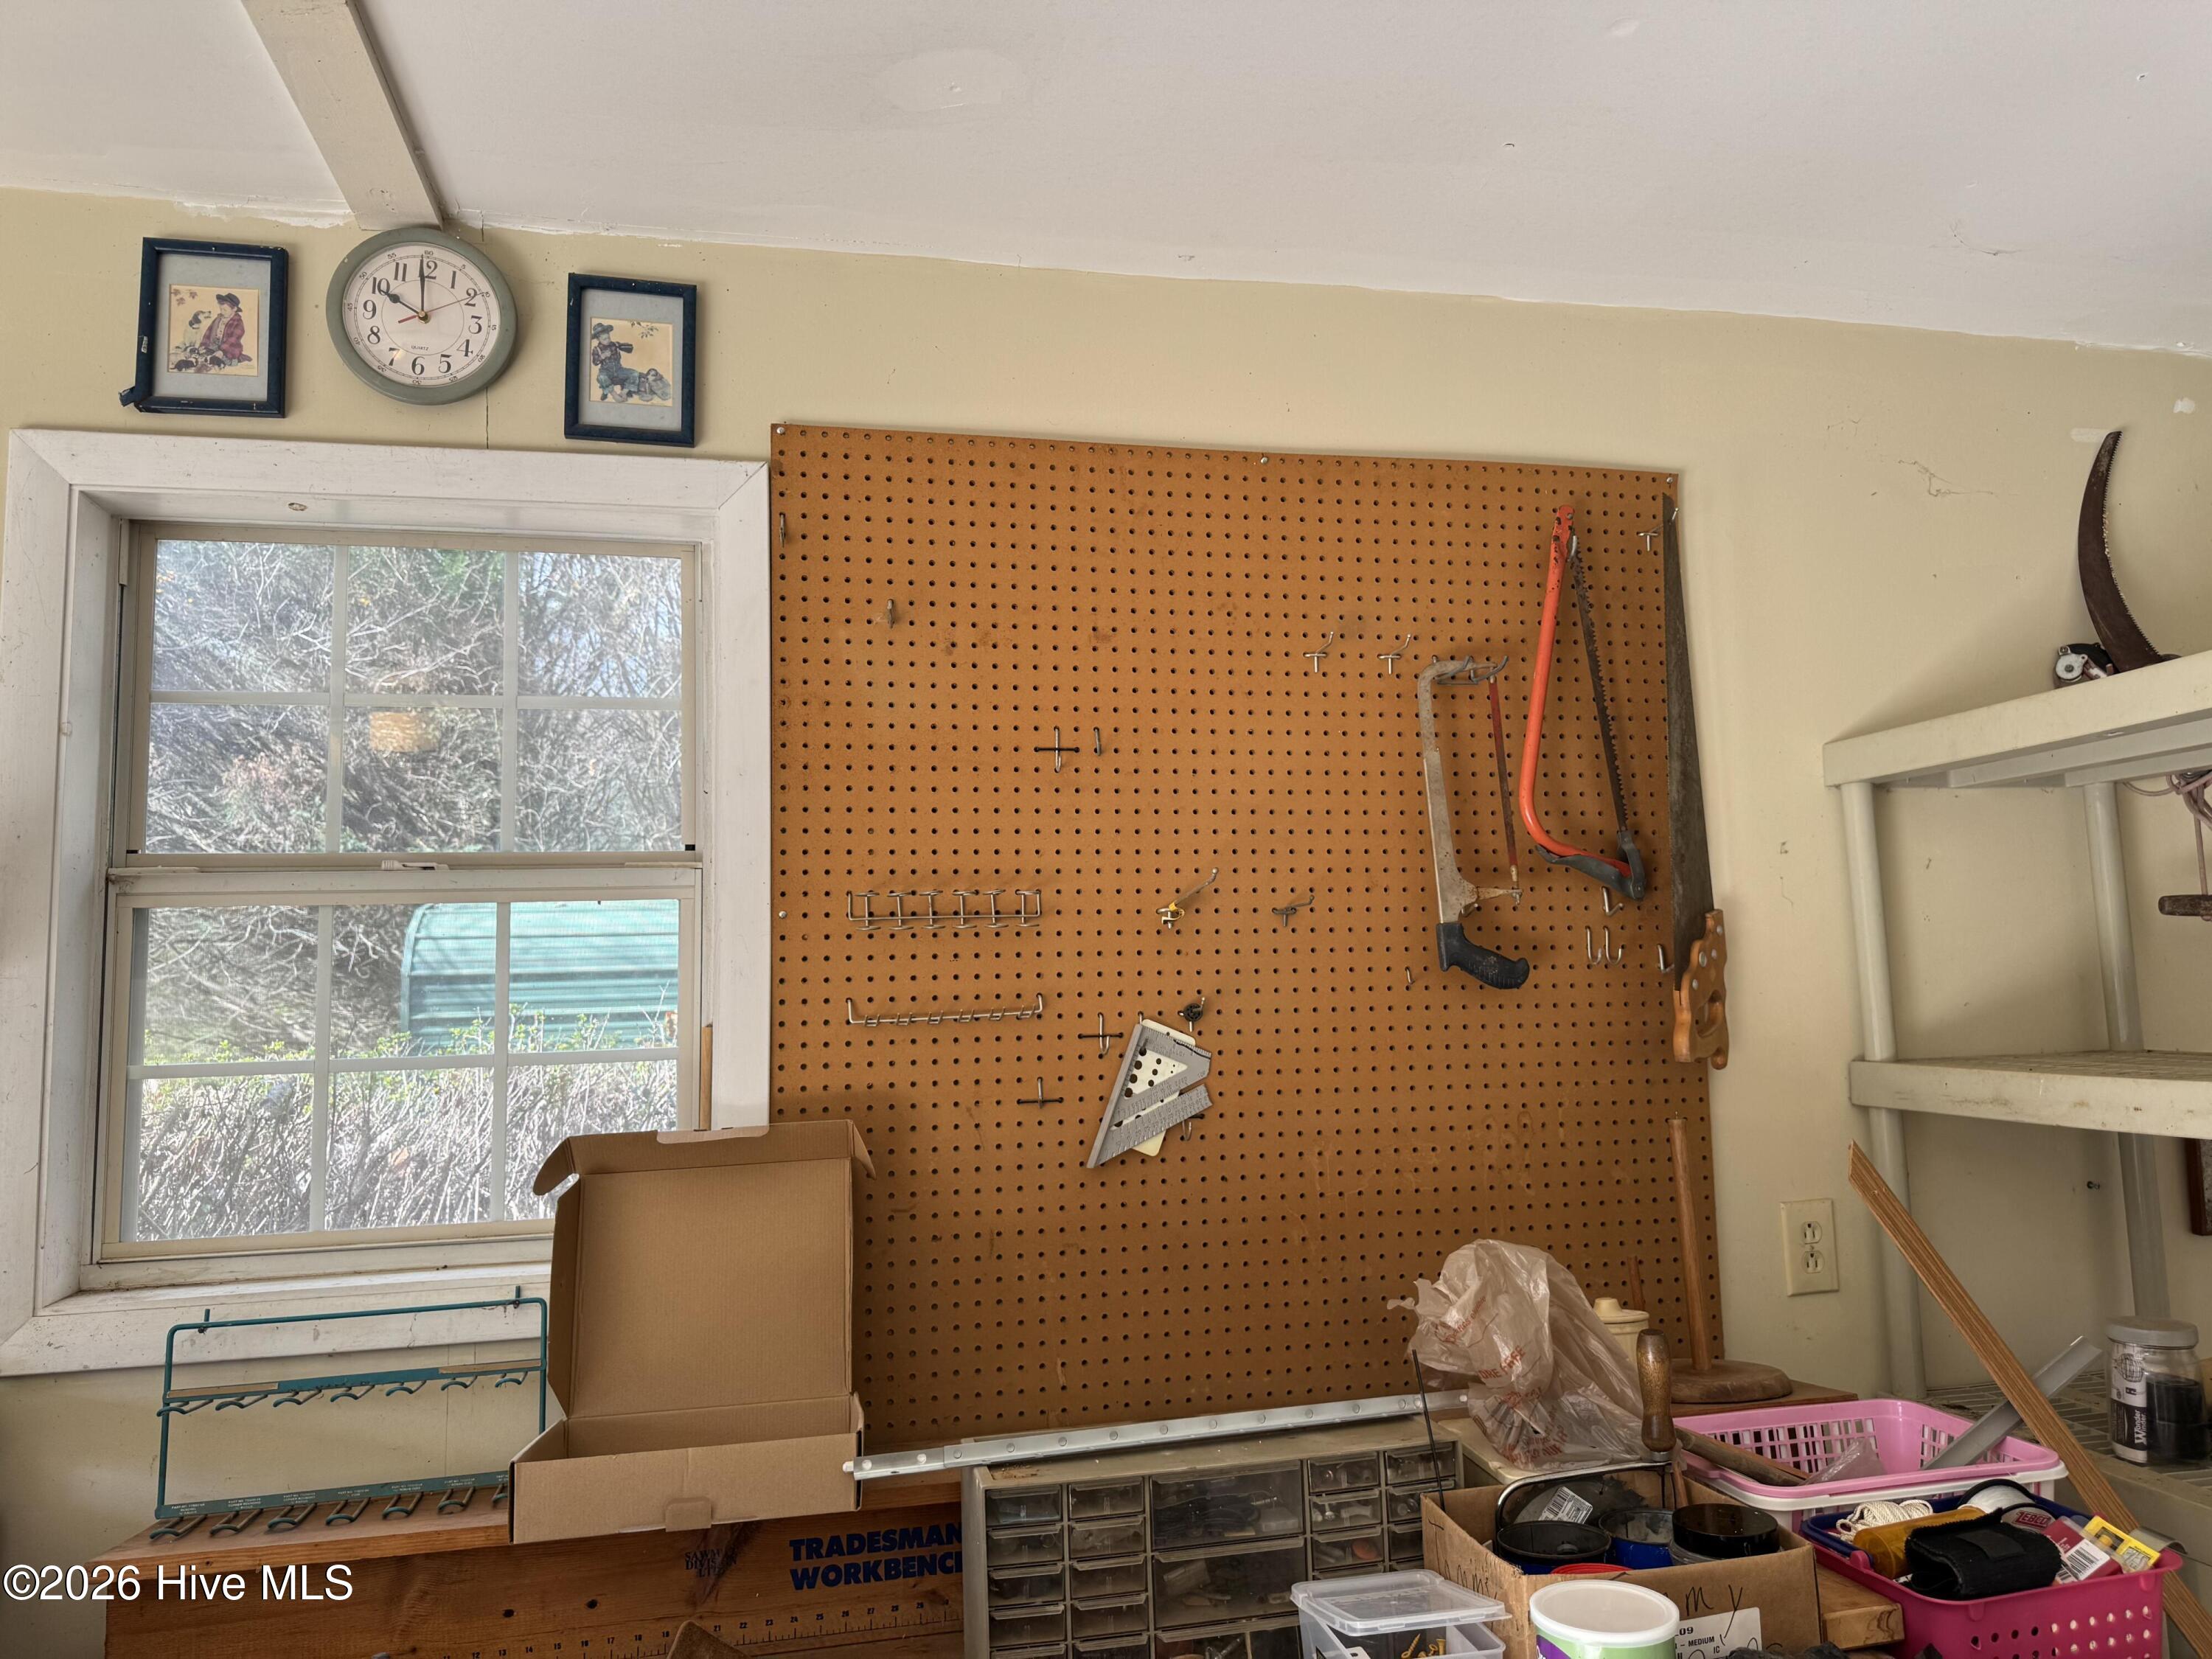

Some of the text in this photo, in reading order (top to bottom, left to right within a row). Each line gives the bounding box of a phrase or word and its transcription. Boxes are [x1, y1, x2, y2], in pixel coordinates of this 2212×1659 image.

[393, 262, 408, 282] 11
[417, 260, 439, 280] 12
[371, 276, 391, 296] 10
[450, 271, 457, 289] 1
[464, 288, 478, 307] 2
[362, 299, 377, 319] 9
[468, 315, 482, 334] 3
[366, 325, 380, 344] 8
[388, 347, 402, 366] 7
[456, 338, 473, 358] 4
[411, 356, 425, 376] 6
[438, 354, 453, 373] 5
[2016, 1510, 2052, 1528] ZEBCO
[789, 1521, 963, 1562] TRADESMAN
[1675, 1627, 1694, 1636] 09
[1688, 1635, 1715, 1647] MEDIUM
[498, 1649, 507, 1657] 13
